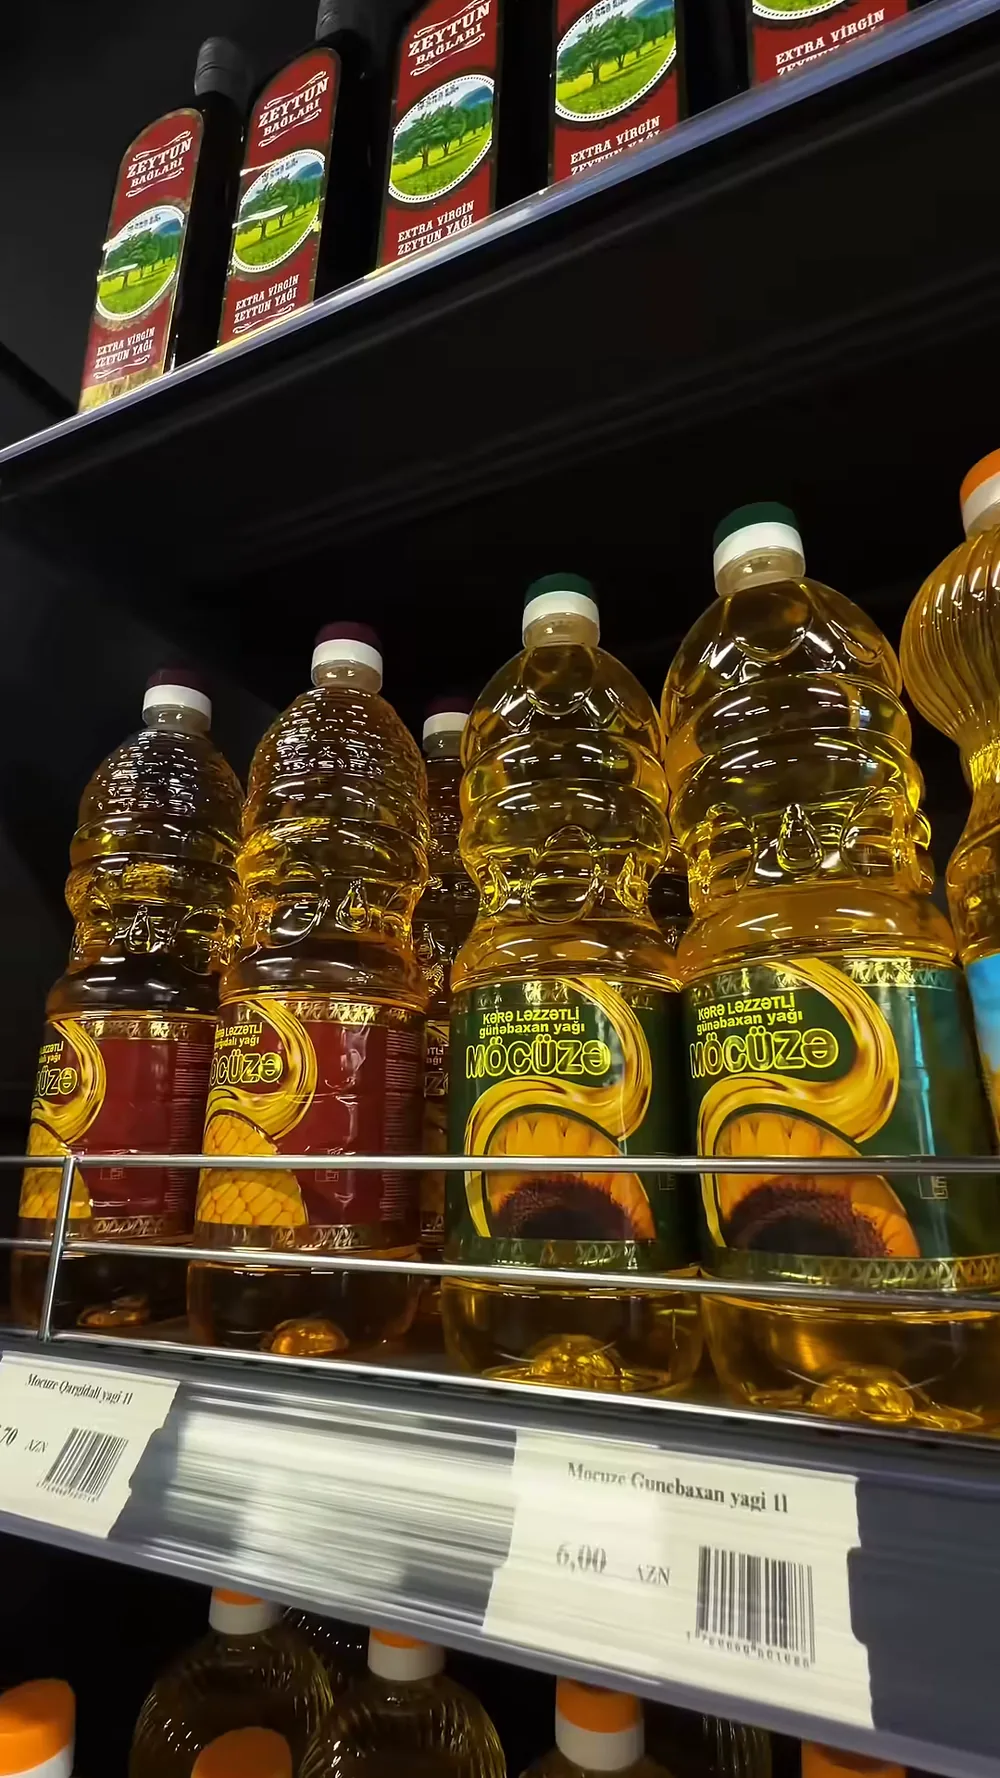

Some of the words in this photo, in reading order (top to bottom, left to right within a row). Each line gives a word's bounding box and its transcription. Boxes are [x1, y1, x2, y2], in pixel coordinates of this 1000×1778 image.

[408, 0, 491, 57] ZEYTUN
[415, 22, 482, 66] BAĞLARI
[775, 36, 826, 66] EXTRA
[830, 8, 885, 43] VİRGİN
[258, 77, 329, 128] ZEYTUN
[263, 98, 320, 136] BAĞLARI
[127, 136, 193, 178] ZEYTUN
[570, 139, 612, 165] EXTRA
[616, 116, 660, 145] VİRGİN
[397, 220, 433, 242] EXTRA
[437, 200, 474, 227] VİRGİN
[397, 229, 442, 256] ZEYTUN
[446, 213, 473, 236] YAĞI
[234, 300, 272, 324] ZEYTUN
[235, 291, 265, 311] EXTRA
[268, 274, 300, 297] VİRGİN
[97, 340, 124, 356] EXTRA
[483, 1010, 513, 1025] KƏRƏ
[517, 1006, 579, 1021] LƏZZƏTLİ
[697, 1013, 762, 1035] günəbaxan
[767, 1009, 803, 1025] yağı
[698, 1004, 725, 1020] KƏRƏ
[728, 992, 795, 1014] LƏZZƏTLİ
[479, 1022, 549, 1039] günəbaxan
[554, 1020, 585, 1035] yağı
[466, 1034, 611, 1079] MÖCÜZƏ
[690, 1025, 839, 1079] MÖCÜZƏ
[0, 1424, 18, 1446] 70
[568, 1462, 626, 1486] Mocuze
[631, 1471, 725, 1503] Gunebaxan
[730, 1491, 766, 1511] yagi
[556, 1541, 606, 1573] 6,00
